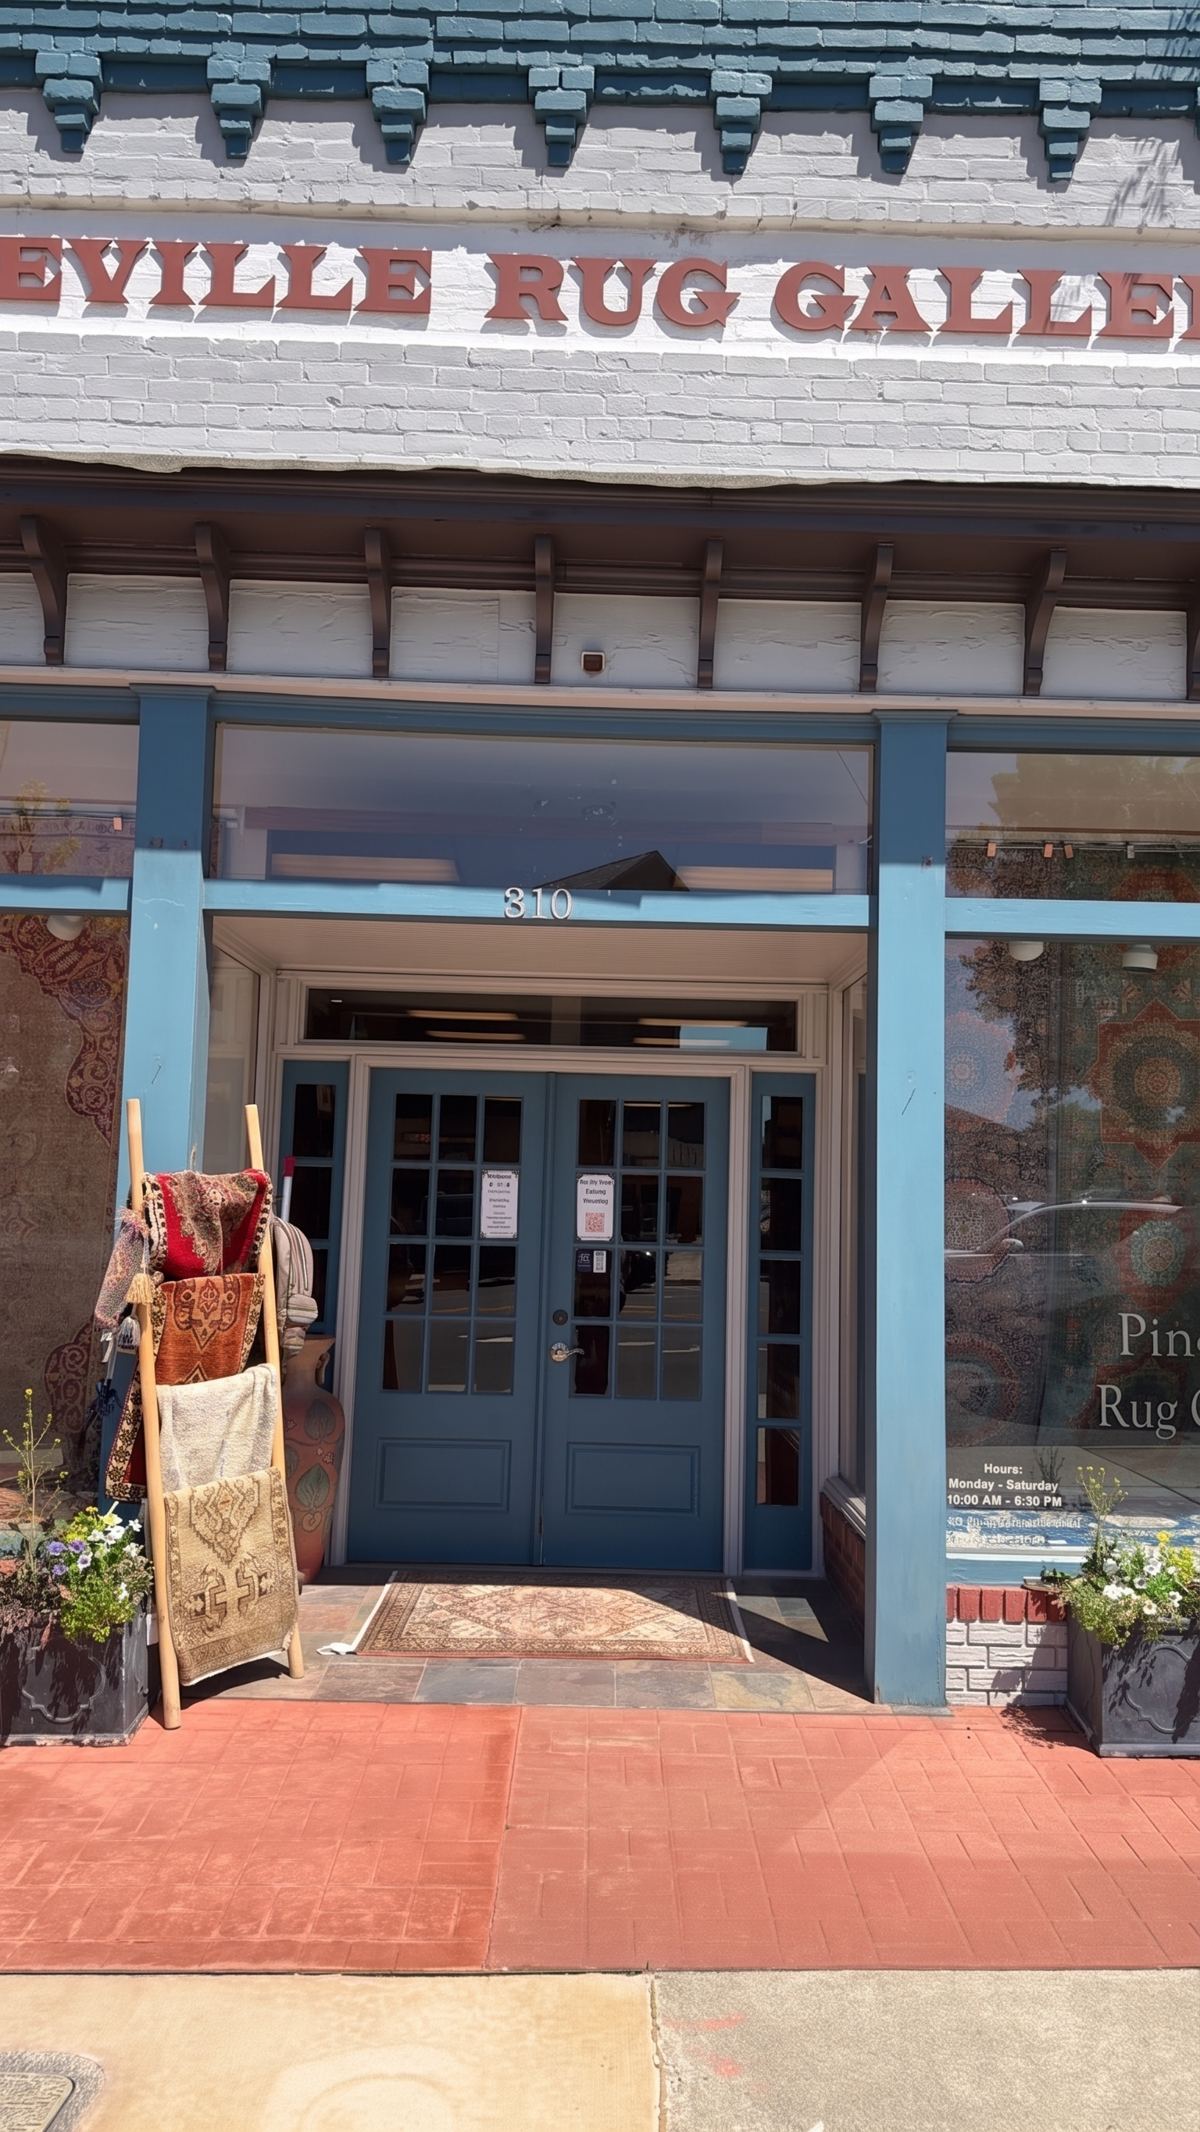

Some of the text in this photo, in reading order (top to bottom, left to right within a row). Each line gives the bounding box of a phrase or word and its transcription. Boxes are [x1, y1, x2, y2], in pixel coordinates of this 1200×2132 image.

[483, 253, 742, 328] RUG
[770, 259, 1200, 340] GALLE
[504, 886, 573, 920] 310
[1117, 1312, 1200, 1358] Pin
[1096, 1384, 1178, 1440] Rug
[948, 1478, 995, 1492] Monday
[1005, 1479, 1059, 1494] Saturday
[983, 1463, 1023, 1475] Hours:
[947, 1494, 979, 1506] 10:00
[982, 1494, 1002, 1506] AM
[1014, 1495, 1041, 1507] 6:30
[1043, 1496, 1063, 1507] PM
